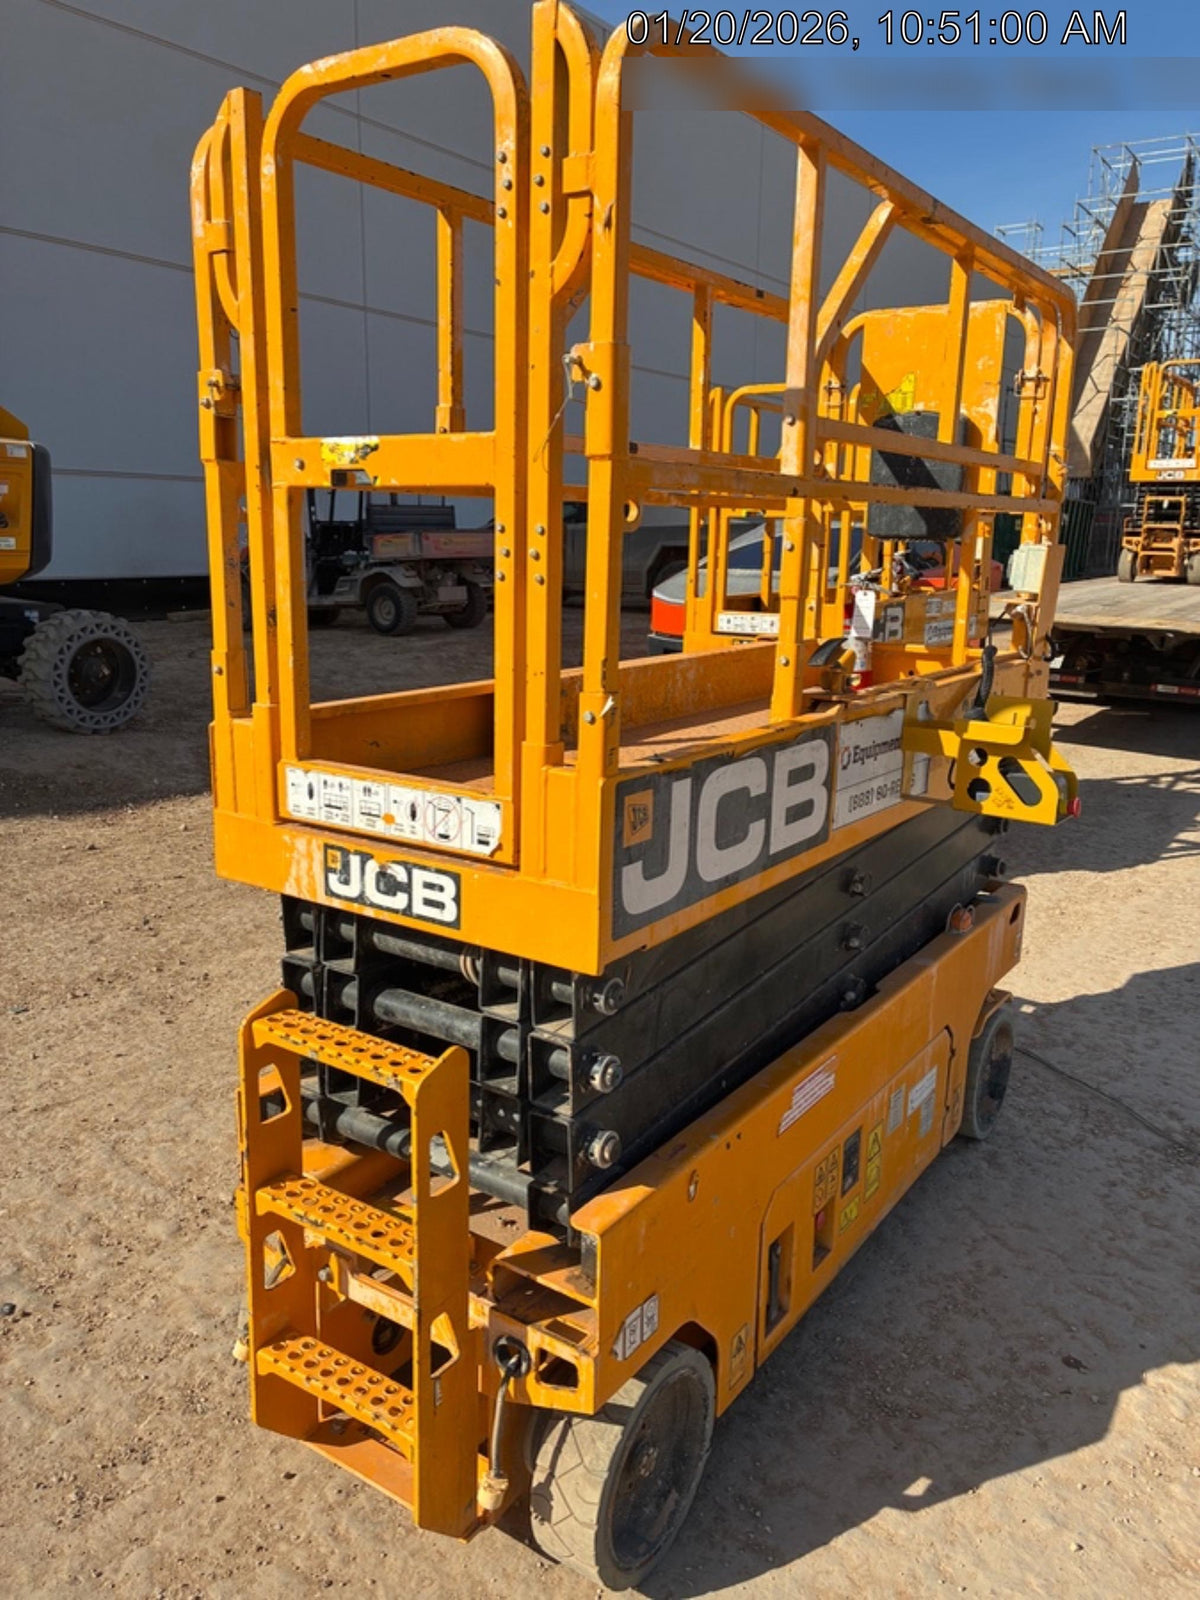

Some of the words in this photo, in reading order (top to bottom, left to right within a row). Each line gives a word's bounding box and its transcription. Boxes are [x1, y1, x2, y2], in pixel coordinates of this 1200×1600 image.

[852, 737, 902, 765] Equipmen
[621, 737, 830, 916] JCB
[327, 852, 458, 923] JCB
